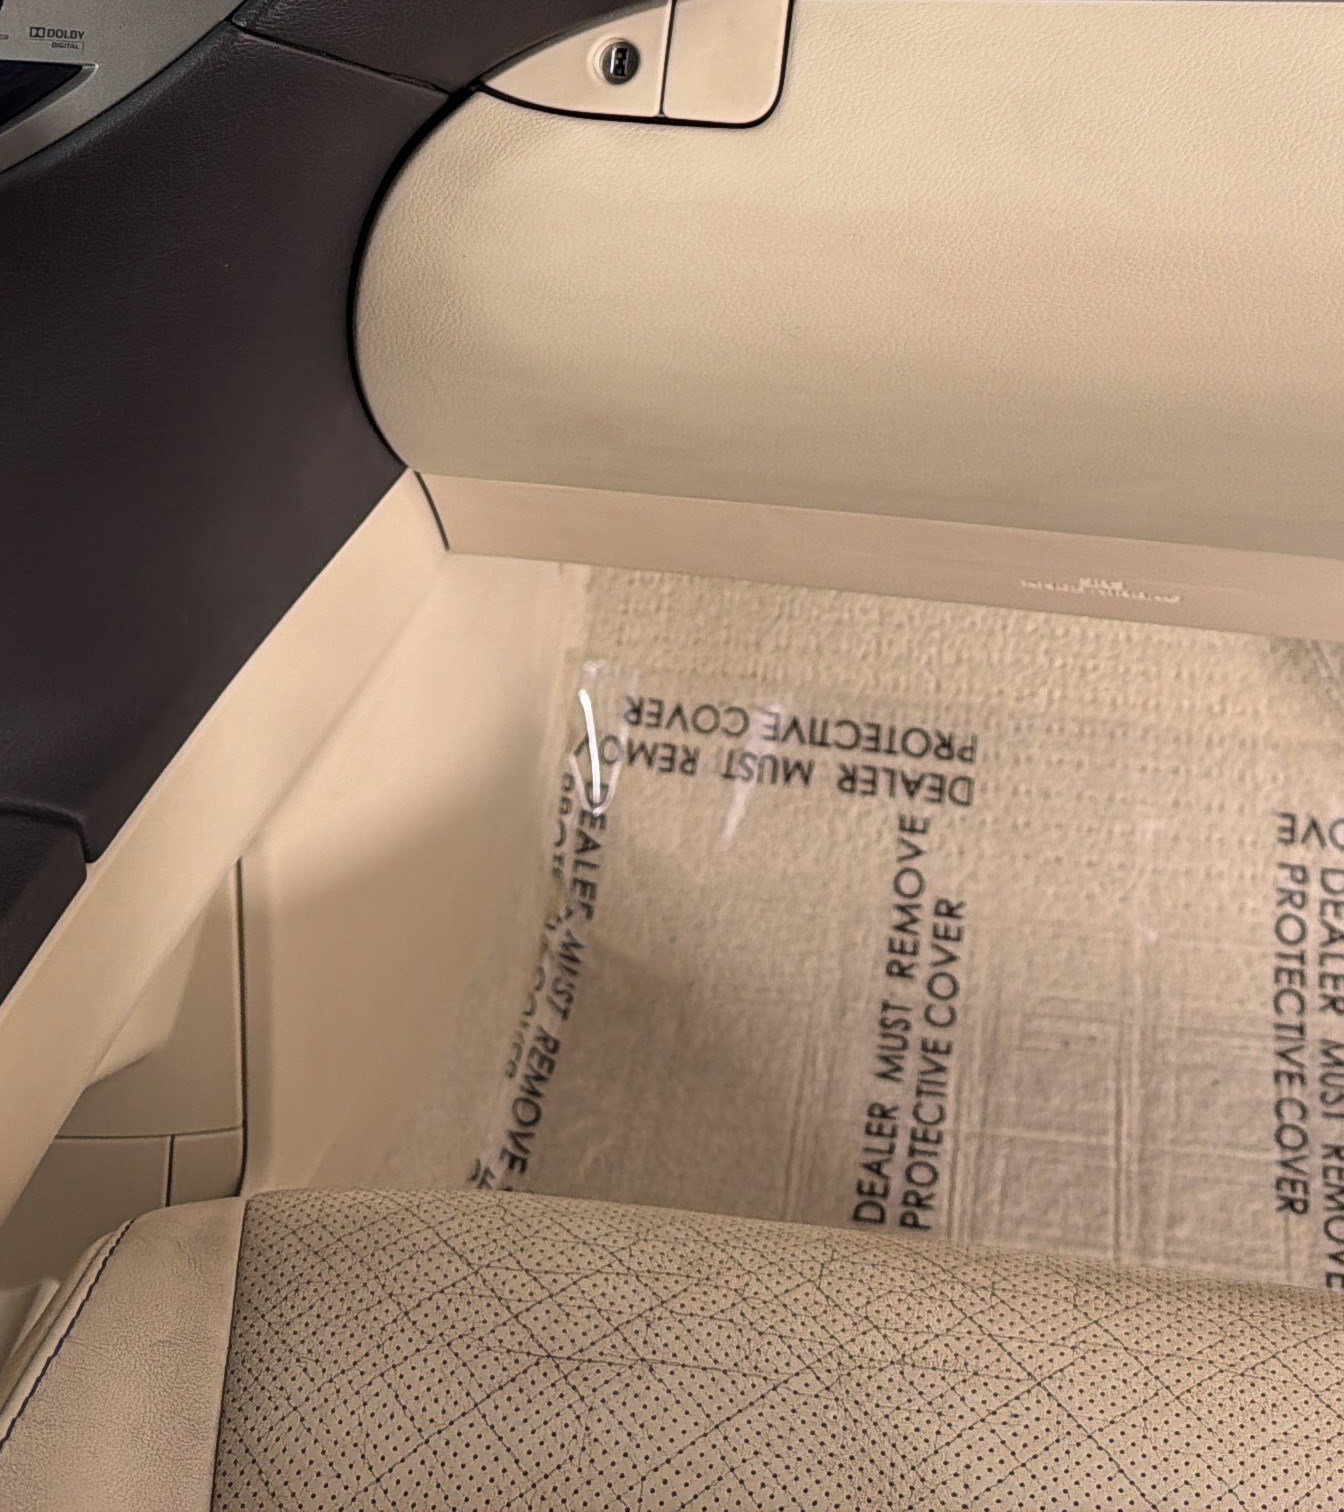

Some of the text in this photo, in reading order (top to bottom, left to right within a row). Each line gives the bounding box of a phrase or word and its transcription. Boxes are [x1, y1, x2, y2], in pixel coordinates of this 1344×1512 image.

[46, 28, 86, 40] DOLBY
[622, 694, 978, 765] PROTECTIVE COVER
[721, 746, 815, 786] MUST
[837, 761, 975, 807] DEALER
[852, 812, 930, 1226] DEALER MUST REMOVE
[898, 896, 967, 1232] PROTECTIVE COVER
[1272, 862, 1311, 1217] PROTECTIVE COVER
[499, 1024, 561, 1177] REMOVE
